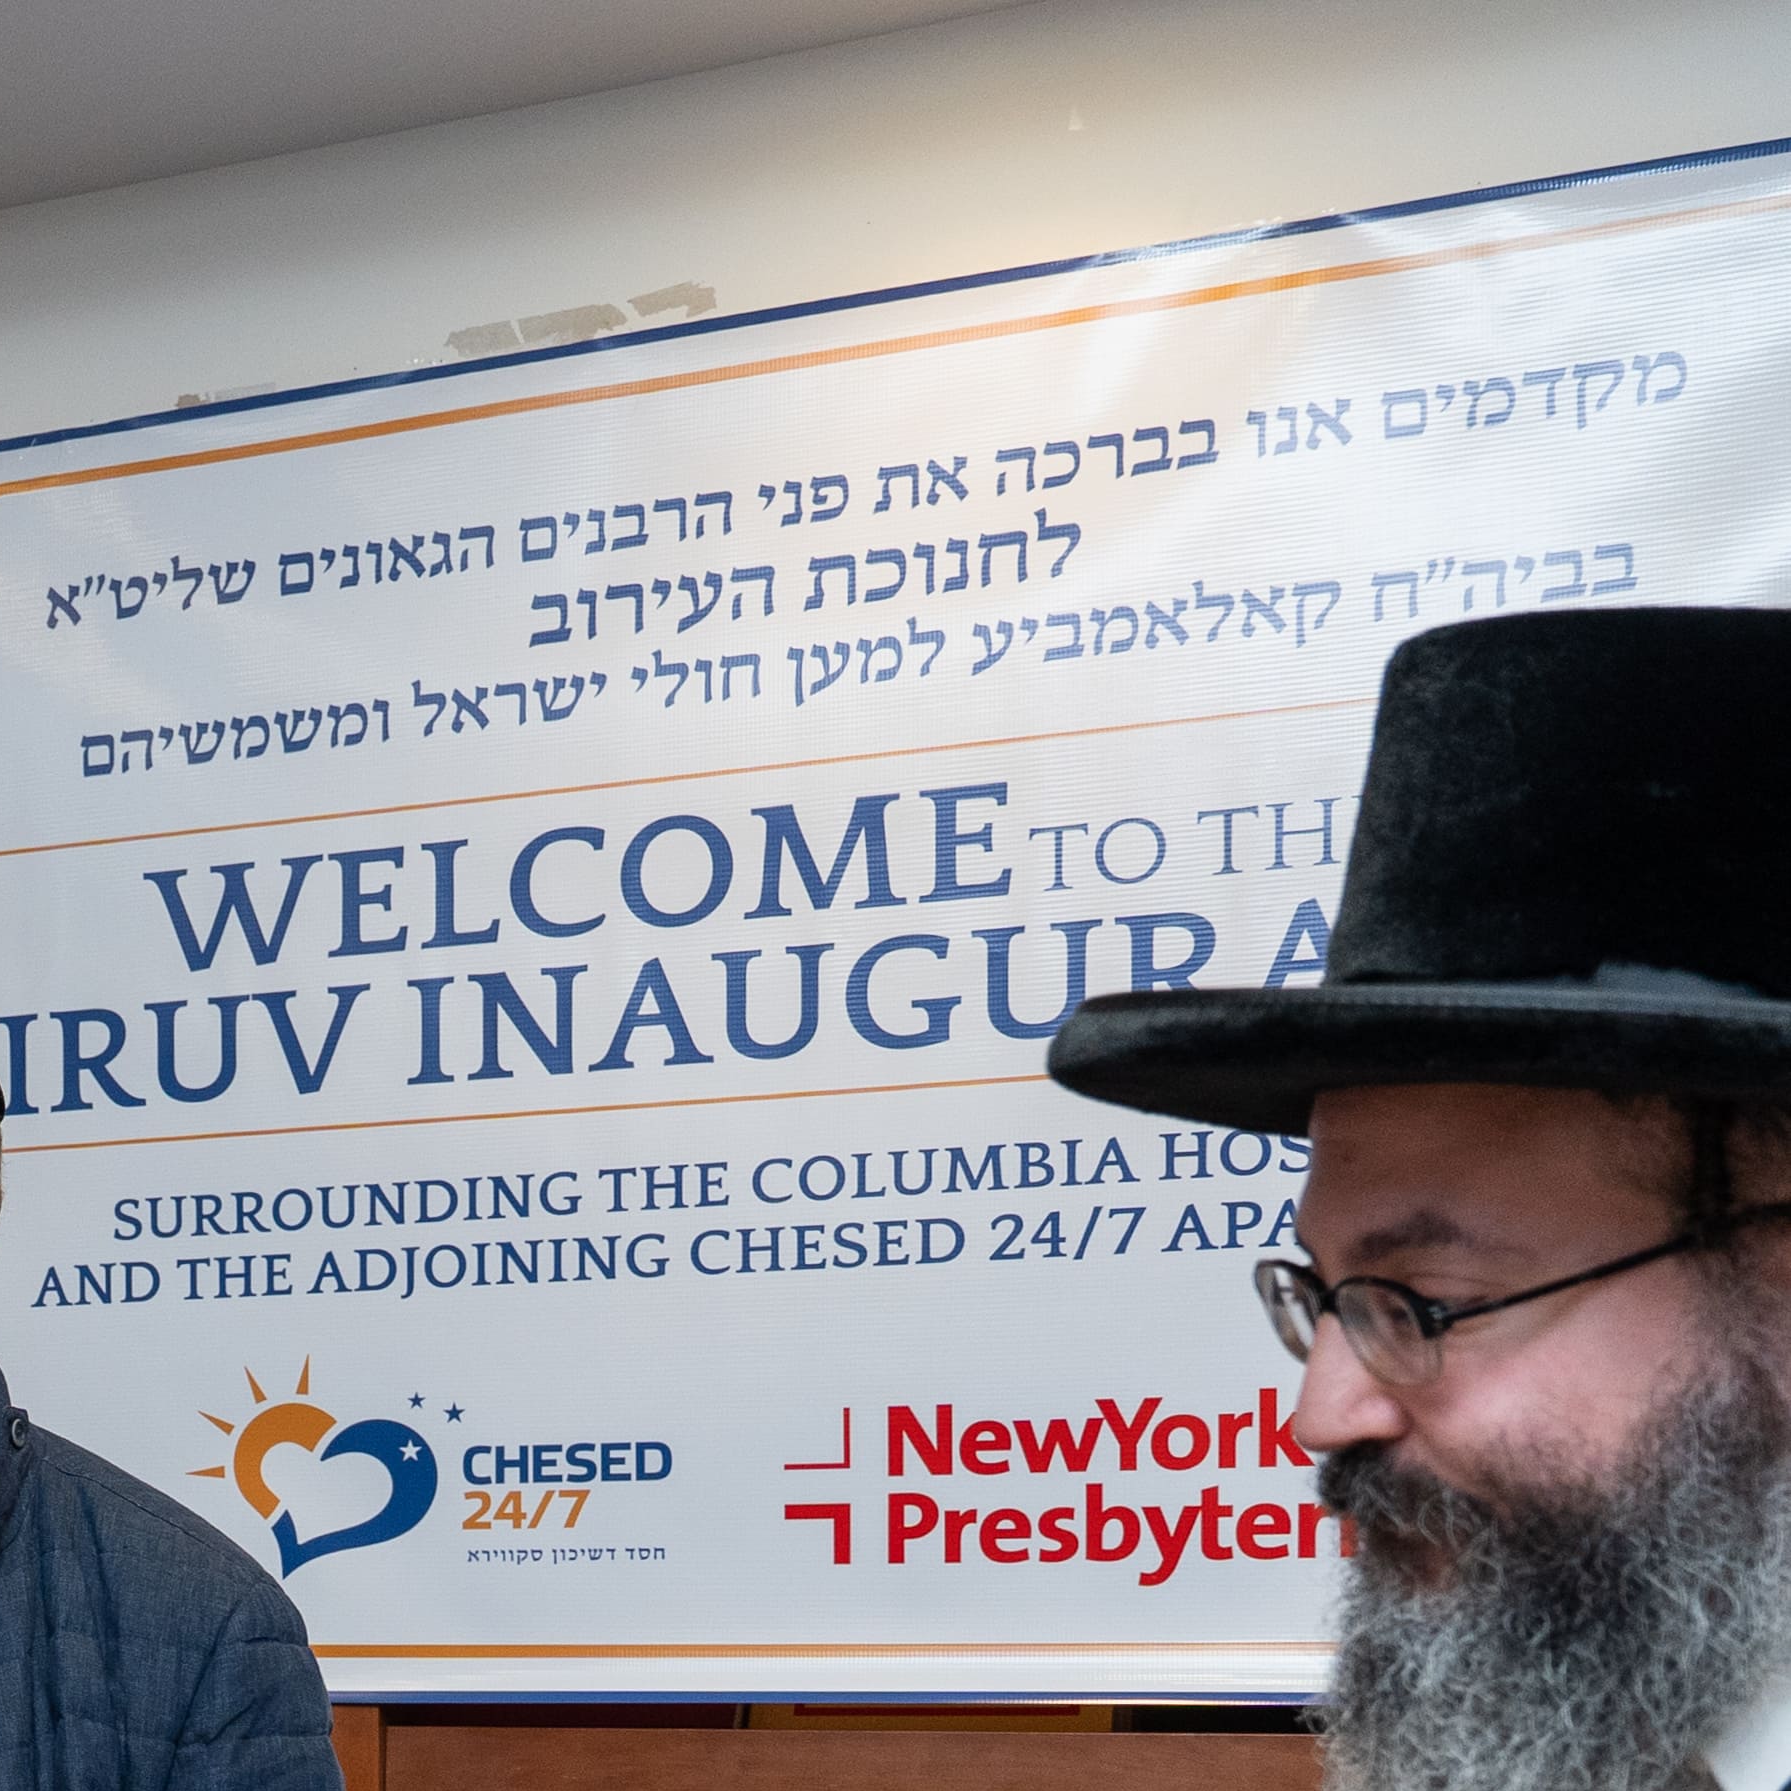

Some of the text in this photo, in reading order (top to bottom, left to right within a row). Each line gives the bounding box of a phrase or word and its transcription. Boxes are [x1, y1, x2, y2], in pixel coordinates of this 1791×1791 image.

[45, 350, 1690, 630] מקדמים אנו בברכה את פני הרבנים הגאונים שליט"א
[527, 510, 1082, 648] לחנוכת העירוב
[786, 617, 947, 707] למען
[970, 577, 1342, 677] קאלאמביע
[411, 670, 608, 739] ישראל
[630, 649, 761, 706] חולי
[79, 698, 390, 779] ומשמשיהם
[143, 782, 1362, 972] WELCOME TO TH
[112, 1169, 587, 1242] SURROUNDING
[598, 1162, 730, 1214] THE
[750, 1135, 1140, 1203] COLUMBIA
[32, 1260, 168, 1309] AND
[176, 1252, 293, 1303] THE
[308, 1231, 667, 1302] ADJOINING
[688, 1214, 966, 1277] CHESED
[989, 1205, 1147, 1262] 24/7
[462, 1440, 673, 1486] CHESED
[887, 1387, 1315, 1477] NewYork
[461, 1488, 592, 1531] 24/7
[467, 1546, 666, 1566] חסד דשיכון סקווירא
